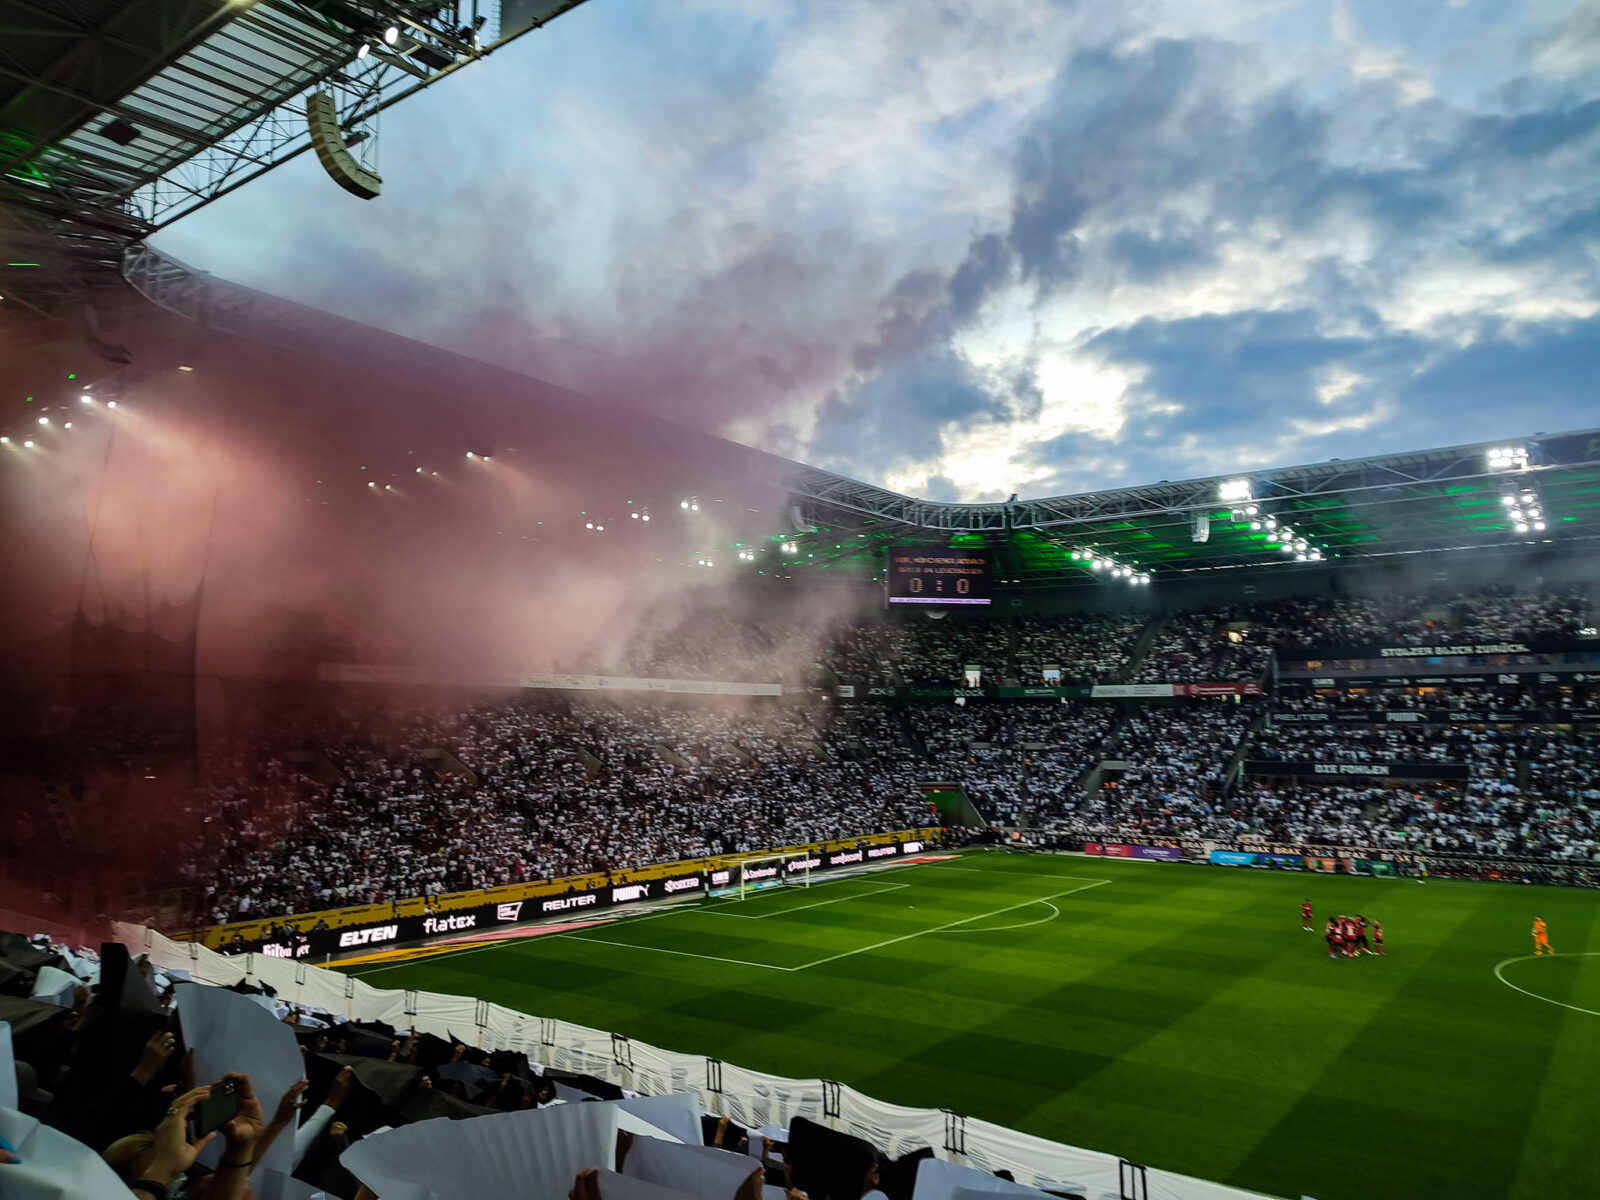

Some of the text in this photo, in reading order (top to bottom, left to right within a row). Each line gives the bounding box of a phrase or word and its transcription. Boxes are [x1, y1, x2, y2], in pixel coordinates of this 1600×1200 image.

[909, 578, 923, 593] 0
[956, 579, 970, 594] 0
[543, 894, 596, 912] REUTER
[423, 915, 476, 934] flatex
[339, 925, 399, 947] ELTEN
